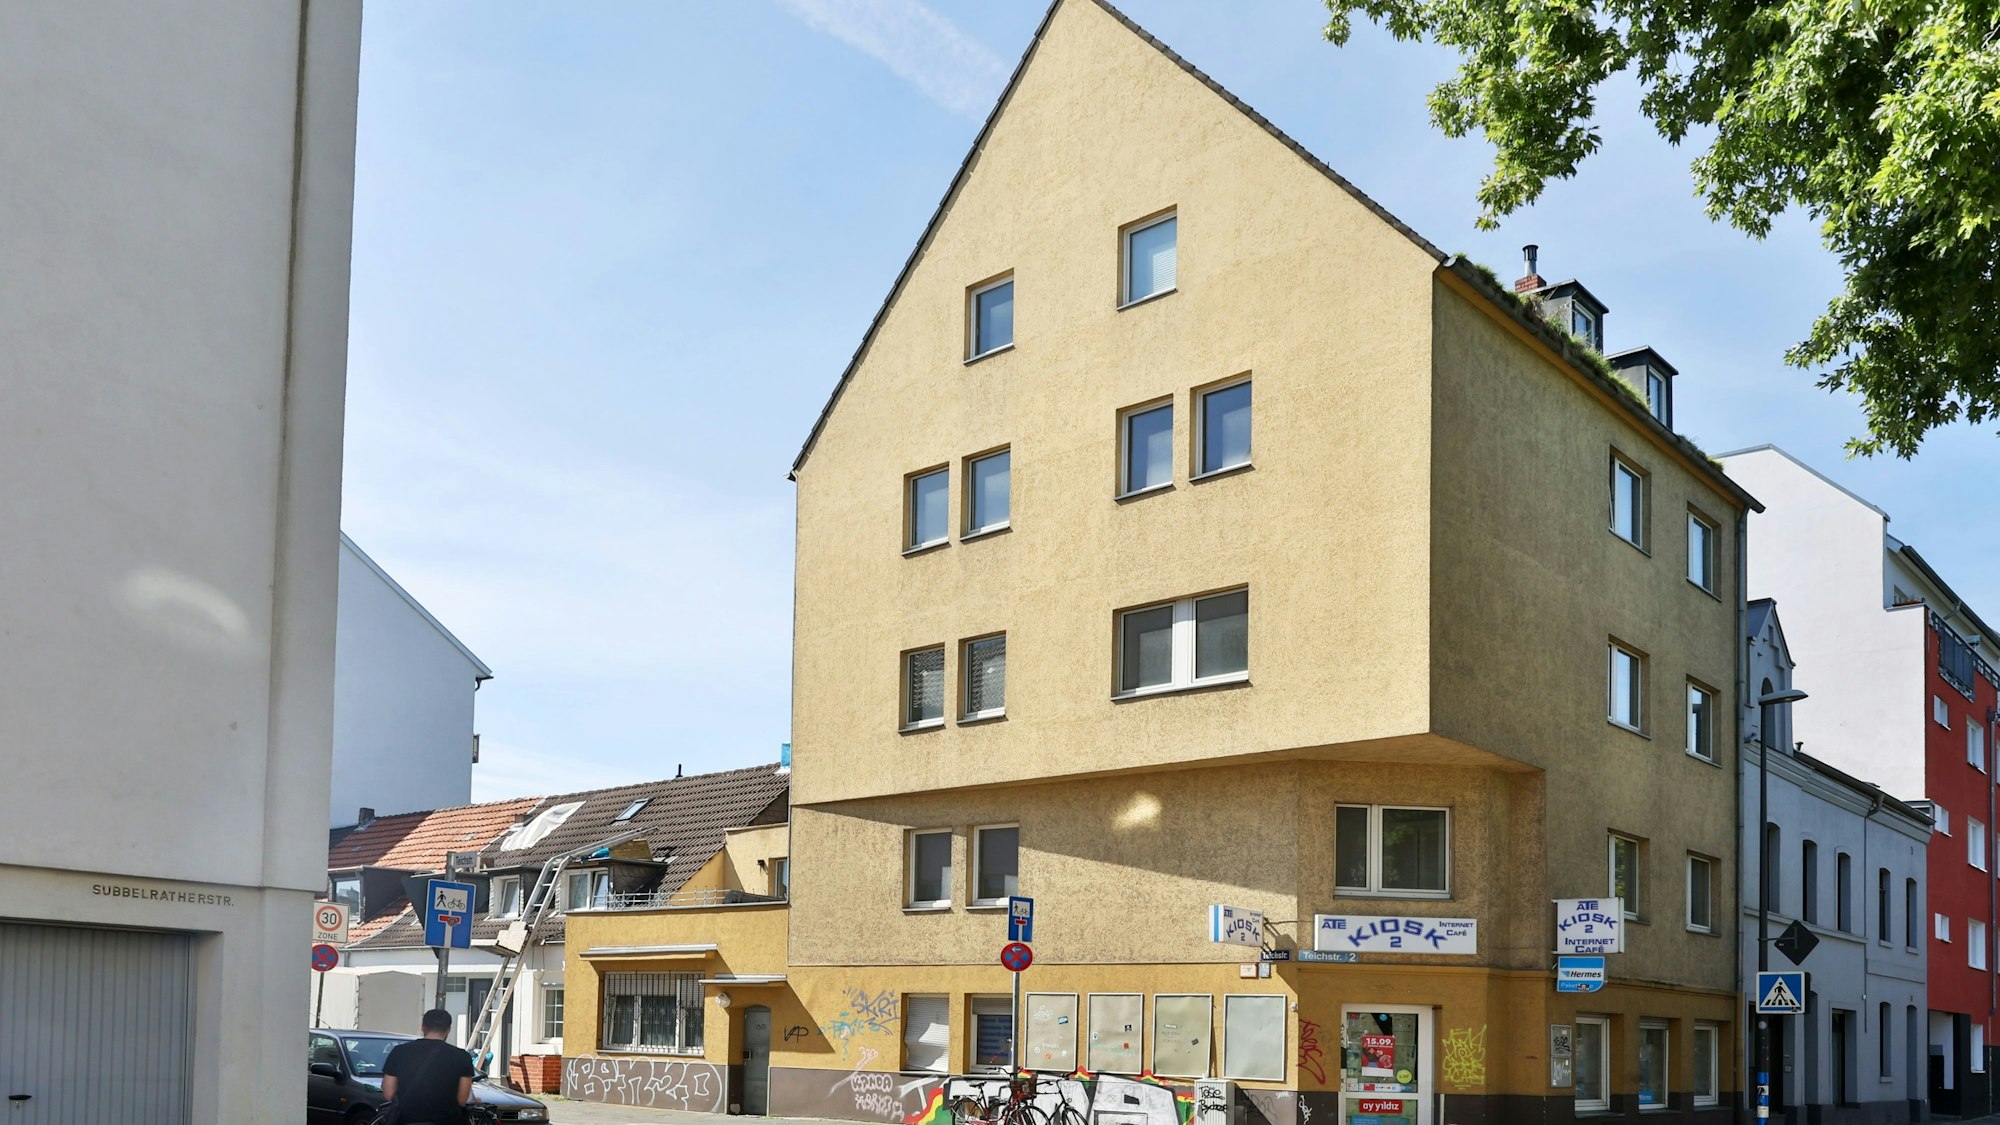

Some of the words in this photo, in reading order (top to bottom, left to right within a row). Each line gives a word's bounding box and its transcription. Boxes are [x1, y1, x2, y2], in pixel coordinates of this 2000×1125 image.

[92, 884, 235, 907] SUBBELRATHERSTR.
[1576, 900, 1599, 911] ATE
[321, 912, 337, 925] 30
[1322, 918, 1347, 930] ATE
[1558, 912, 1618, 932] KIOSK
[1226, 918, 1261, 942] KIOSK
[1347, 918, 1448, 950] KIOSK
[1584, 924, 1594, 934] 2
[317, 931, 339, 941] ZONE
[1240, 932, 1246, 942] 2
[1390, 936, 1402, 948] 2
[1303, 952, 1343, 962] Teichstr.
[1349, 952, 1356, 962] 2
[1366, 1038, 1393, 1046] 15.09.
[1363, 1103, 1374, 1112] ay
[1375, 1101, 1399, 1112] yıldız
